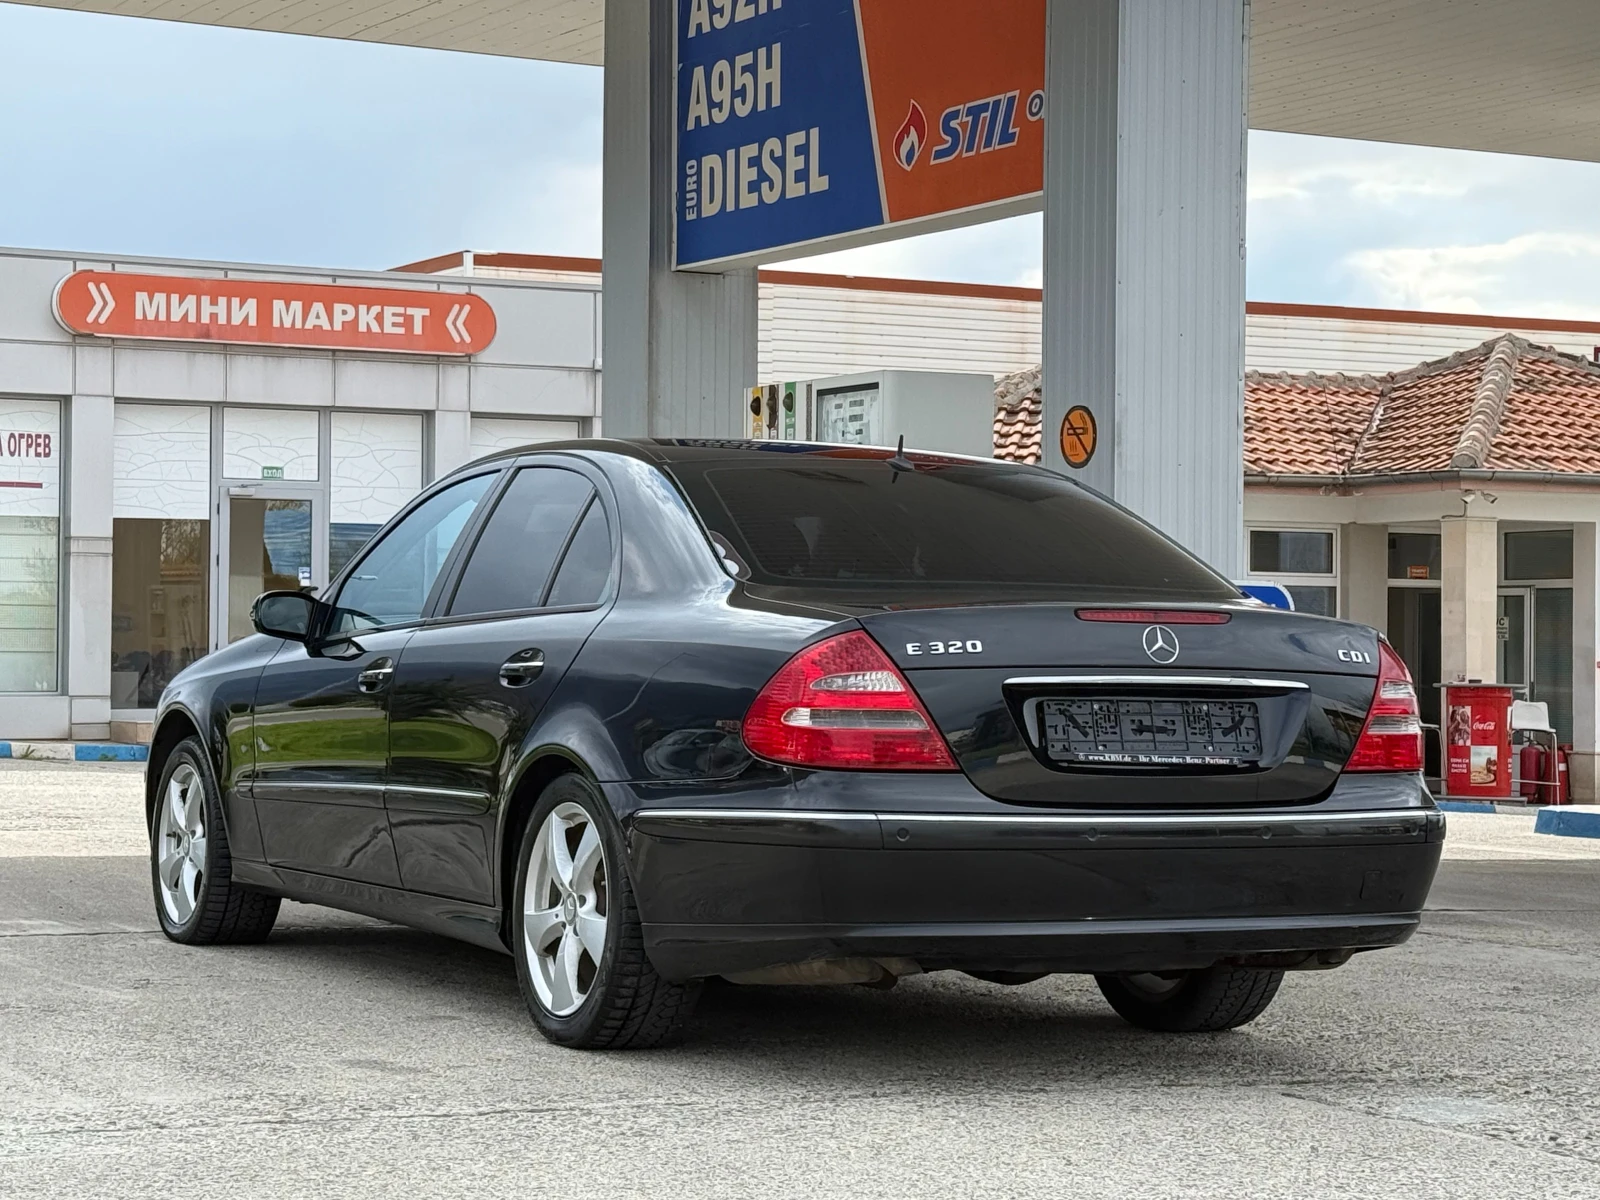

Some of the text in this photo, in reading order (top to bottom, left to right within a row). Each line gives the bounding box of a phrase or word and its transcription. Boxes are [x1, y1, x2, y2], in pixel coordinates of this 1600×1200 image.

[686, 42, 781, 131] A95H
[930, 90, 1020, 165] STIL
[685, 159, 697, 221] EURO
[701, 127, 829, 219] DIESEL
[135, 291, 430, 335] МИНИ МАРКЕТ
[8, 432, 52, 458] ОГРЕВ
[263, 468, 283, 478] ВХОД
[906, 640, 983, 655] E 320
[1337, 649, 1371, 663] CDI
